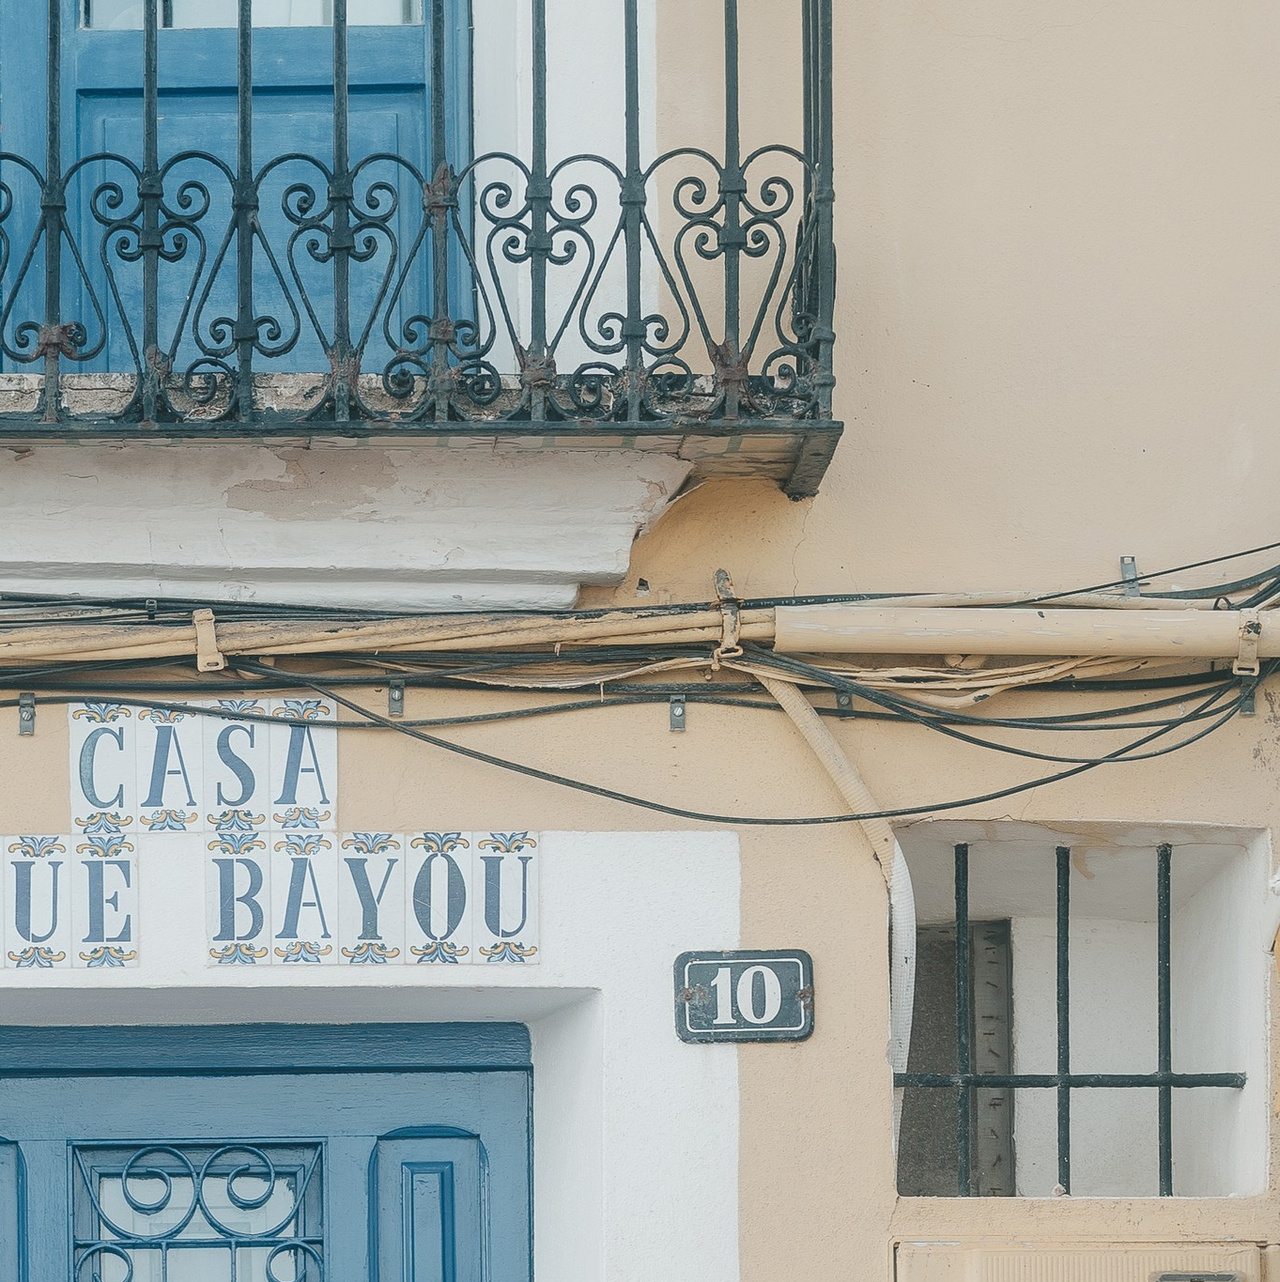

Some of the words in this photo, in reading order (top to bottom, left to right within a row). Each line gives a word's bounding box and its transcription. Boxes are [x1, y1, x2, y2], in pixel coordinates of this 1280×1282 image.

[79, 724, 331, 809] CASA
[212, 853, 533, 941] BAYOU
[710, 965, 782, 1025] 10
